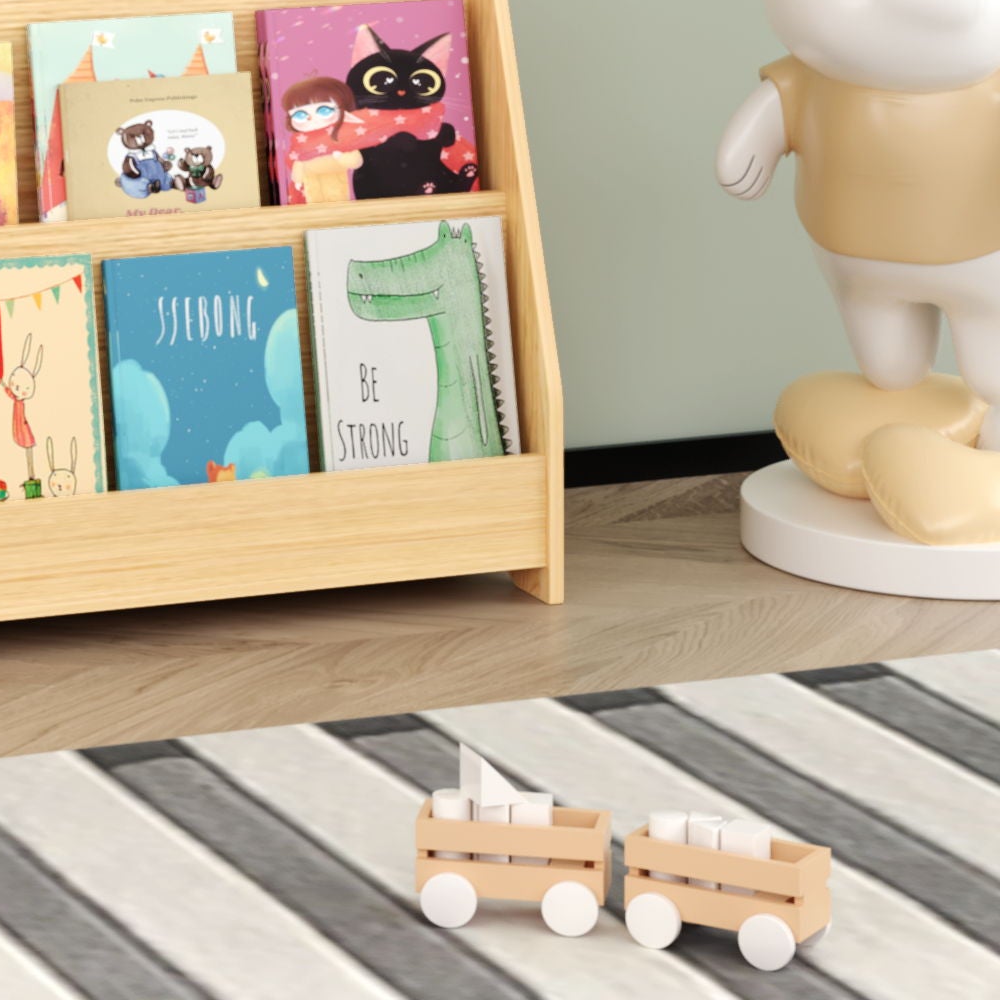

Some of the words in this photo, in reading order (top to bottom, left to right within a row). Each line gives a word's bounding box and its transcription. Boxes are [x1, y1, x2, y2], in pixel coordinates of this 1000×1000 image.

[155, 294, 257, 346] SSEBONG
[359, 362, 380, 403] BE
[337, 419, 409, 463] STRONG
